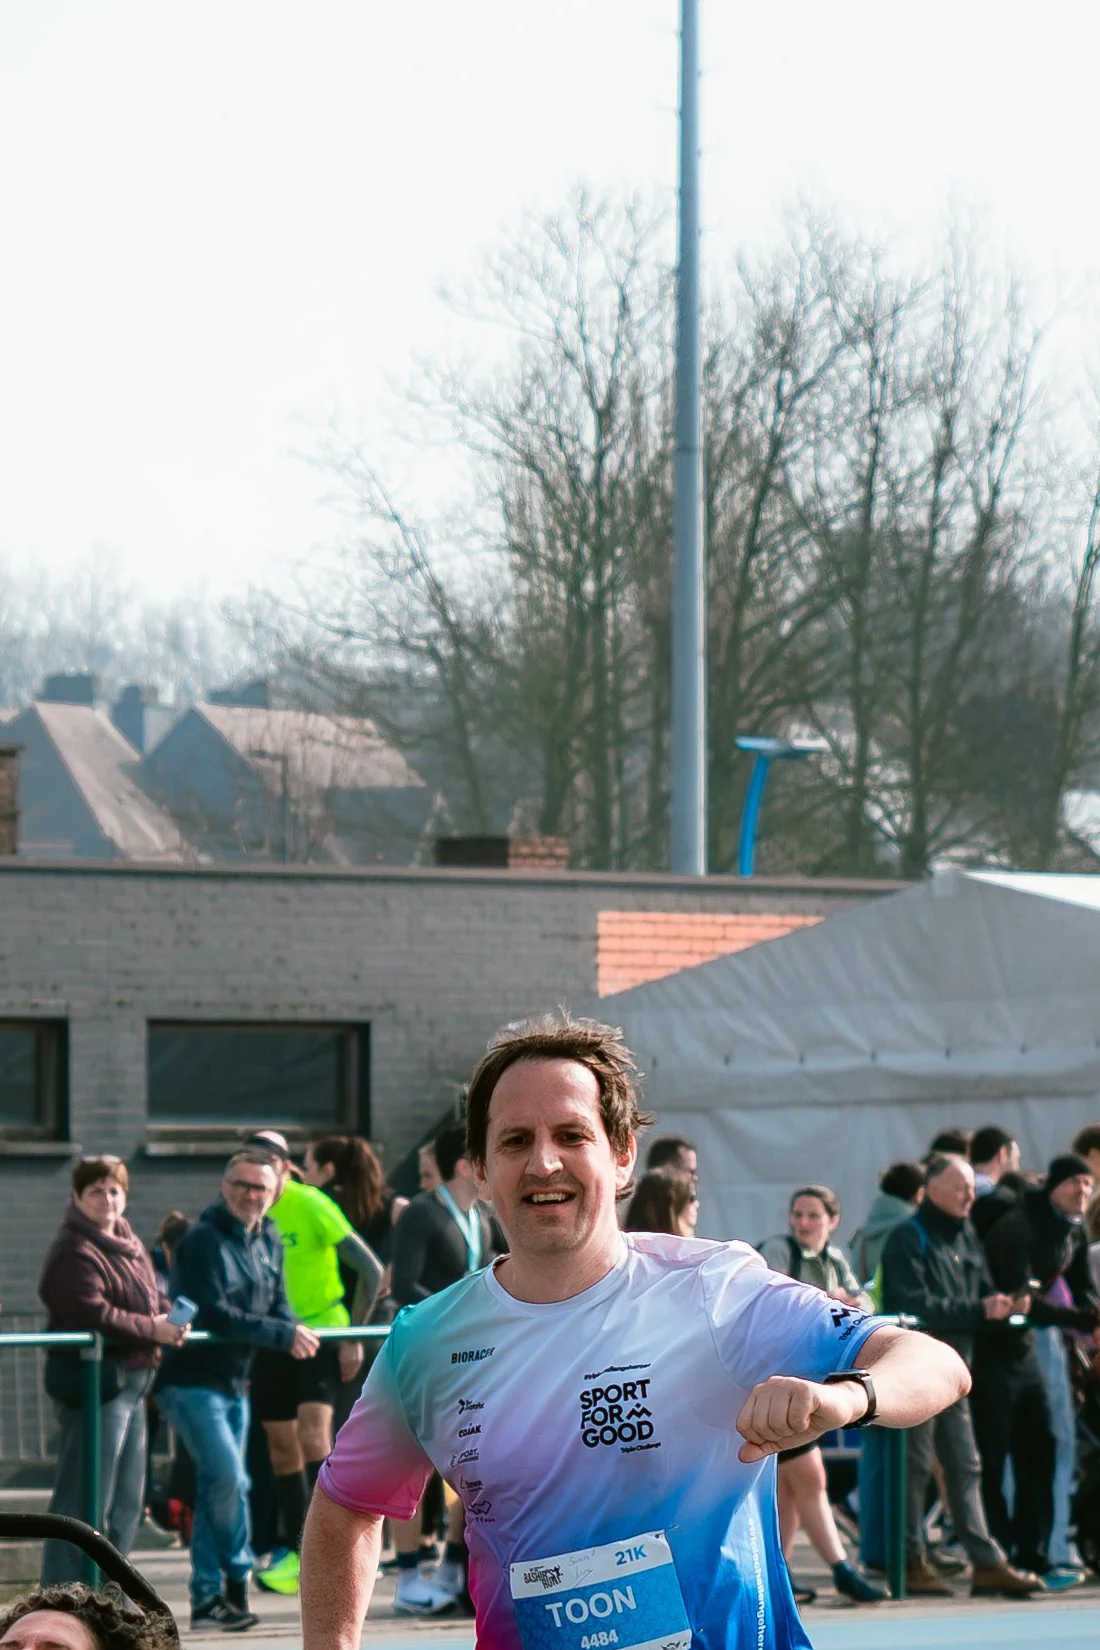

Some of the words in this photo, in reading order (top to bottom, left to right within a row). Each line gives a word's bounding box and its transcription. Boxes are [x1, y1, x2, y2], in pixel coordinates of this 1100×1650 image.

[579, 1378, 651, 1411] SPORT
[580, 1404, 625, 1430] FOR
[581, 1420, 655, 1449] GOOD
[614, 1544, 648, 1567] 21K
[545, 1585, 638, 1628] TOON
[580, 1629, 619, 1650] 4484
